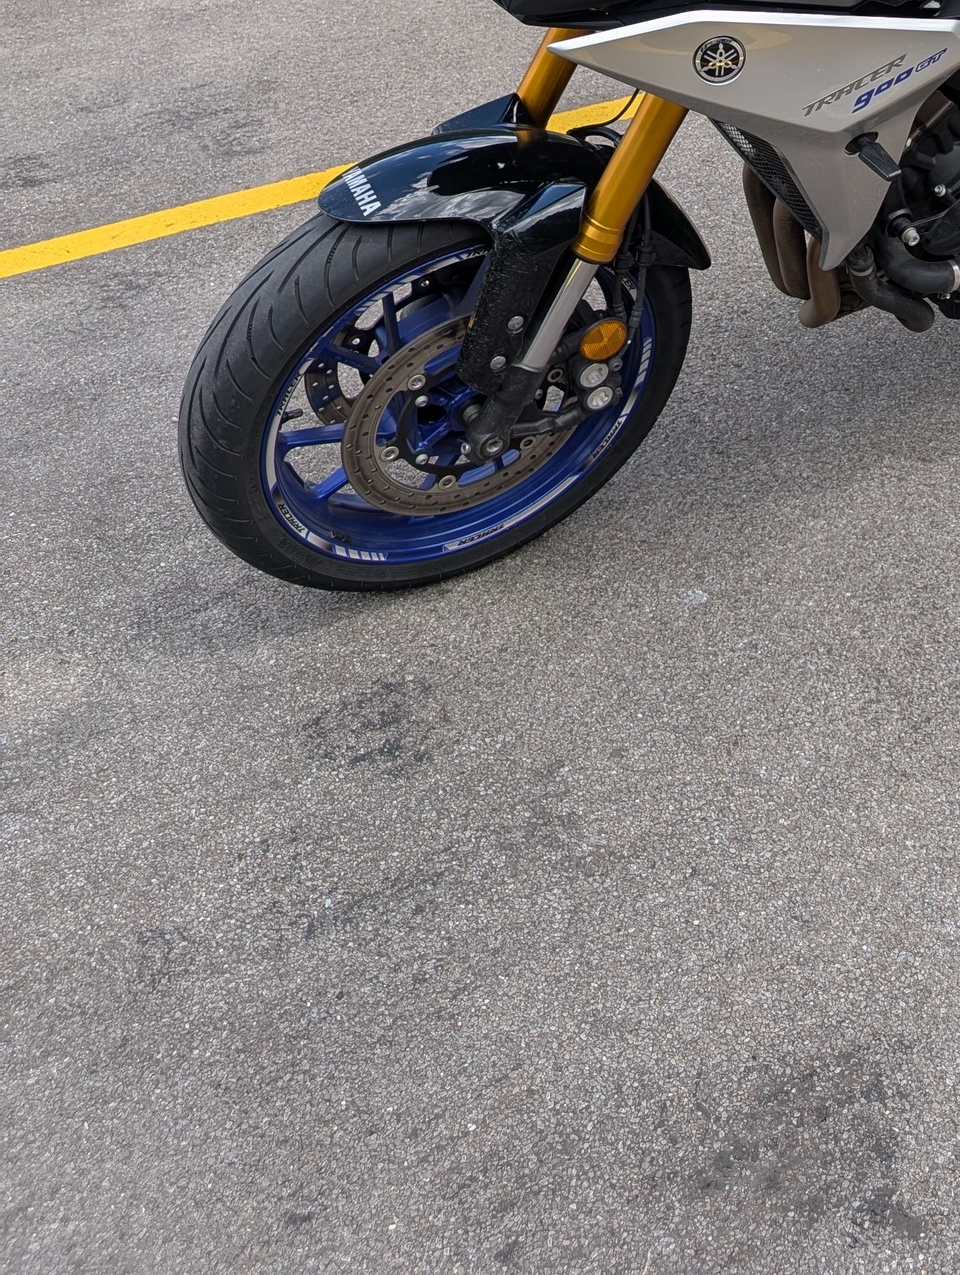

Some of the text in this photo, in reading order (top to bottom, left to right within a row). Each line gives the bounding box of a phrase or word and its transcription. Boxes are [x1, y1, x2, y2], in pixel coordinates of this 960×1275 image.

[802, 52, 908, 117] TRACER
[852, 47, 948, 114] 900 GT
[341, 165, 382, 217] YAMAHA
